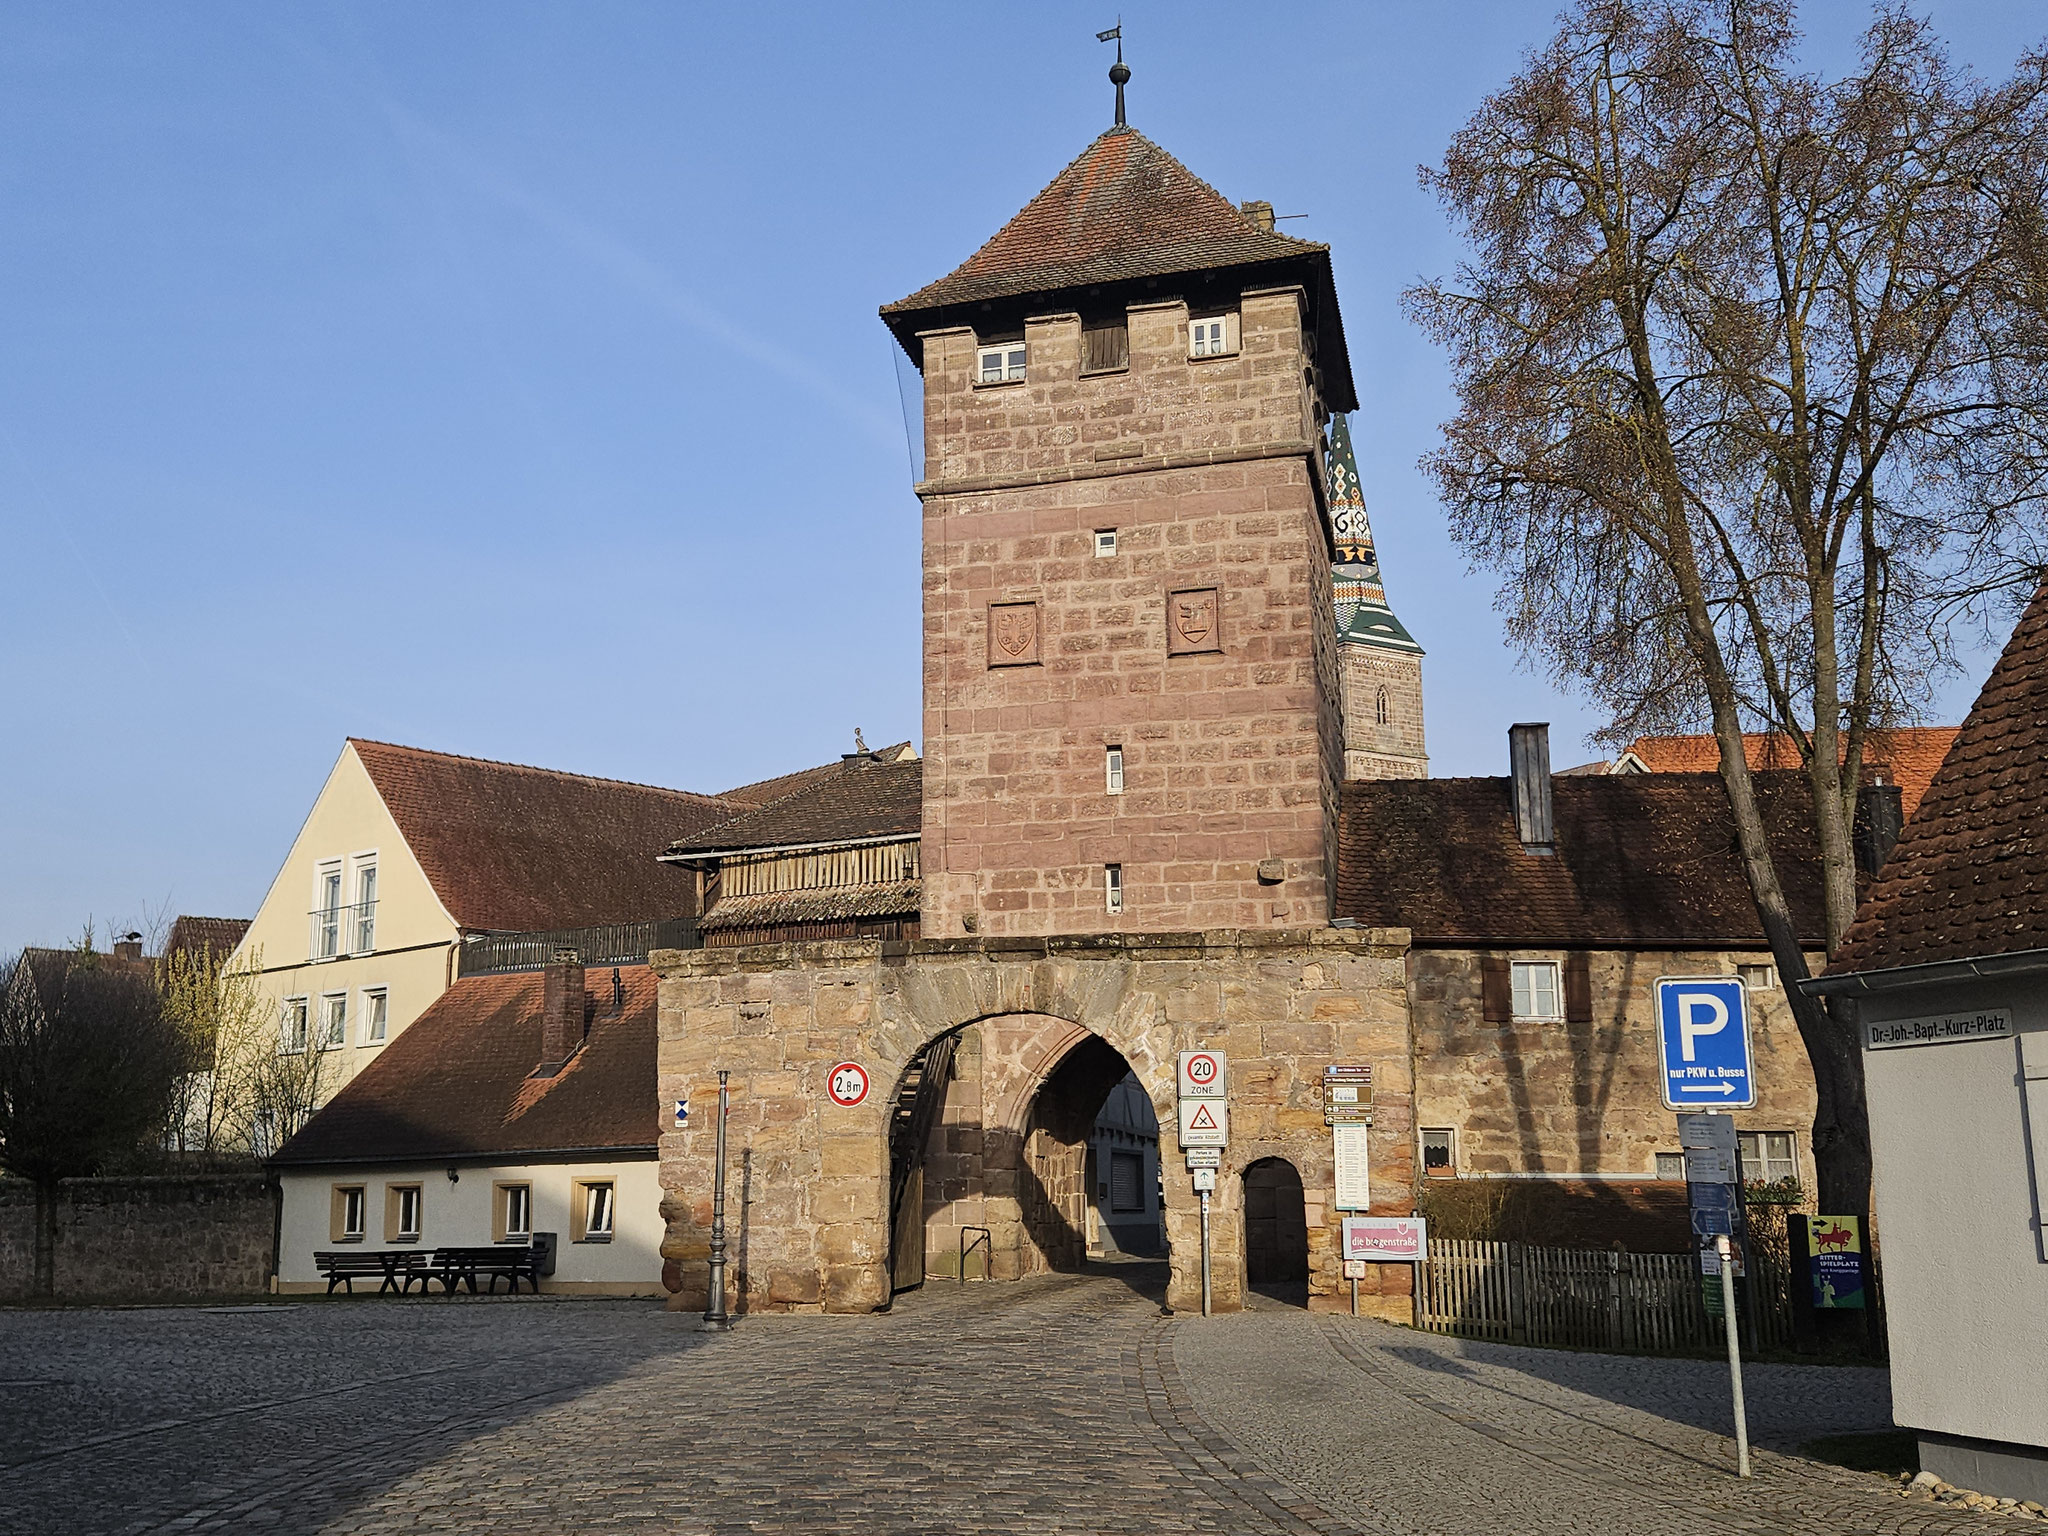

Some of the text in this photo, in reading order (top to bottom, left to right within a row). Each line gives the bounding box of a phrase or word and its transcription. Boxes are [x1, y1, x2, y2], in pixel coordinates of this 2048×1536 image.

[1678, 993, 1729, 1062] P
[1194, 1062, 1211, 1076] 20
[1669, 1066, 1745, 1078] nur PKW u. Busse
[1191, 1086, 1214, 1094] ZONE
[1352, 1236, 1417, 1249] die bgenstraße
